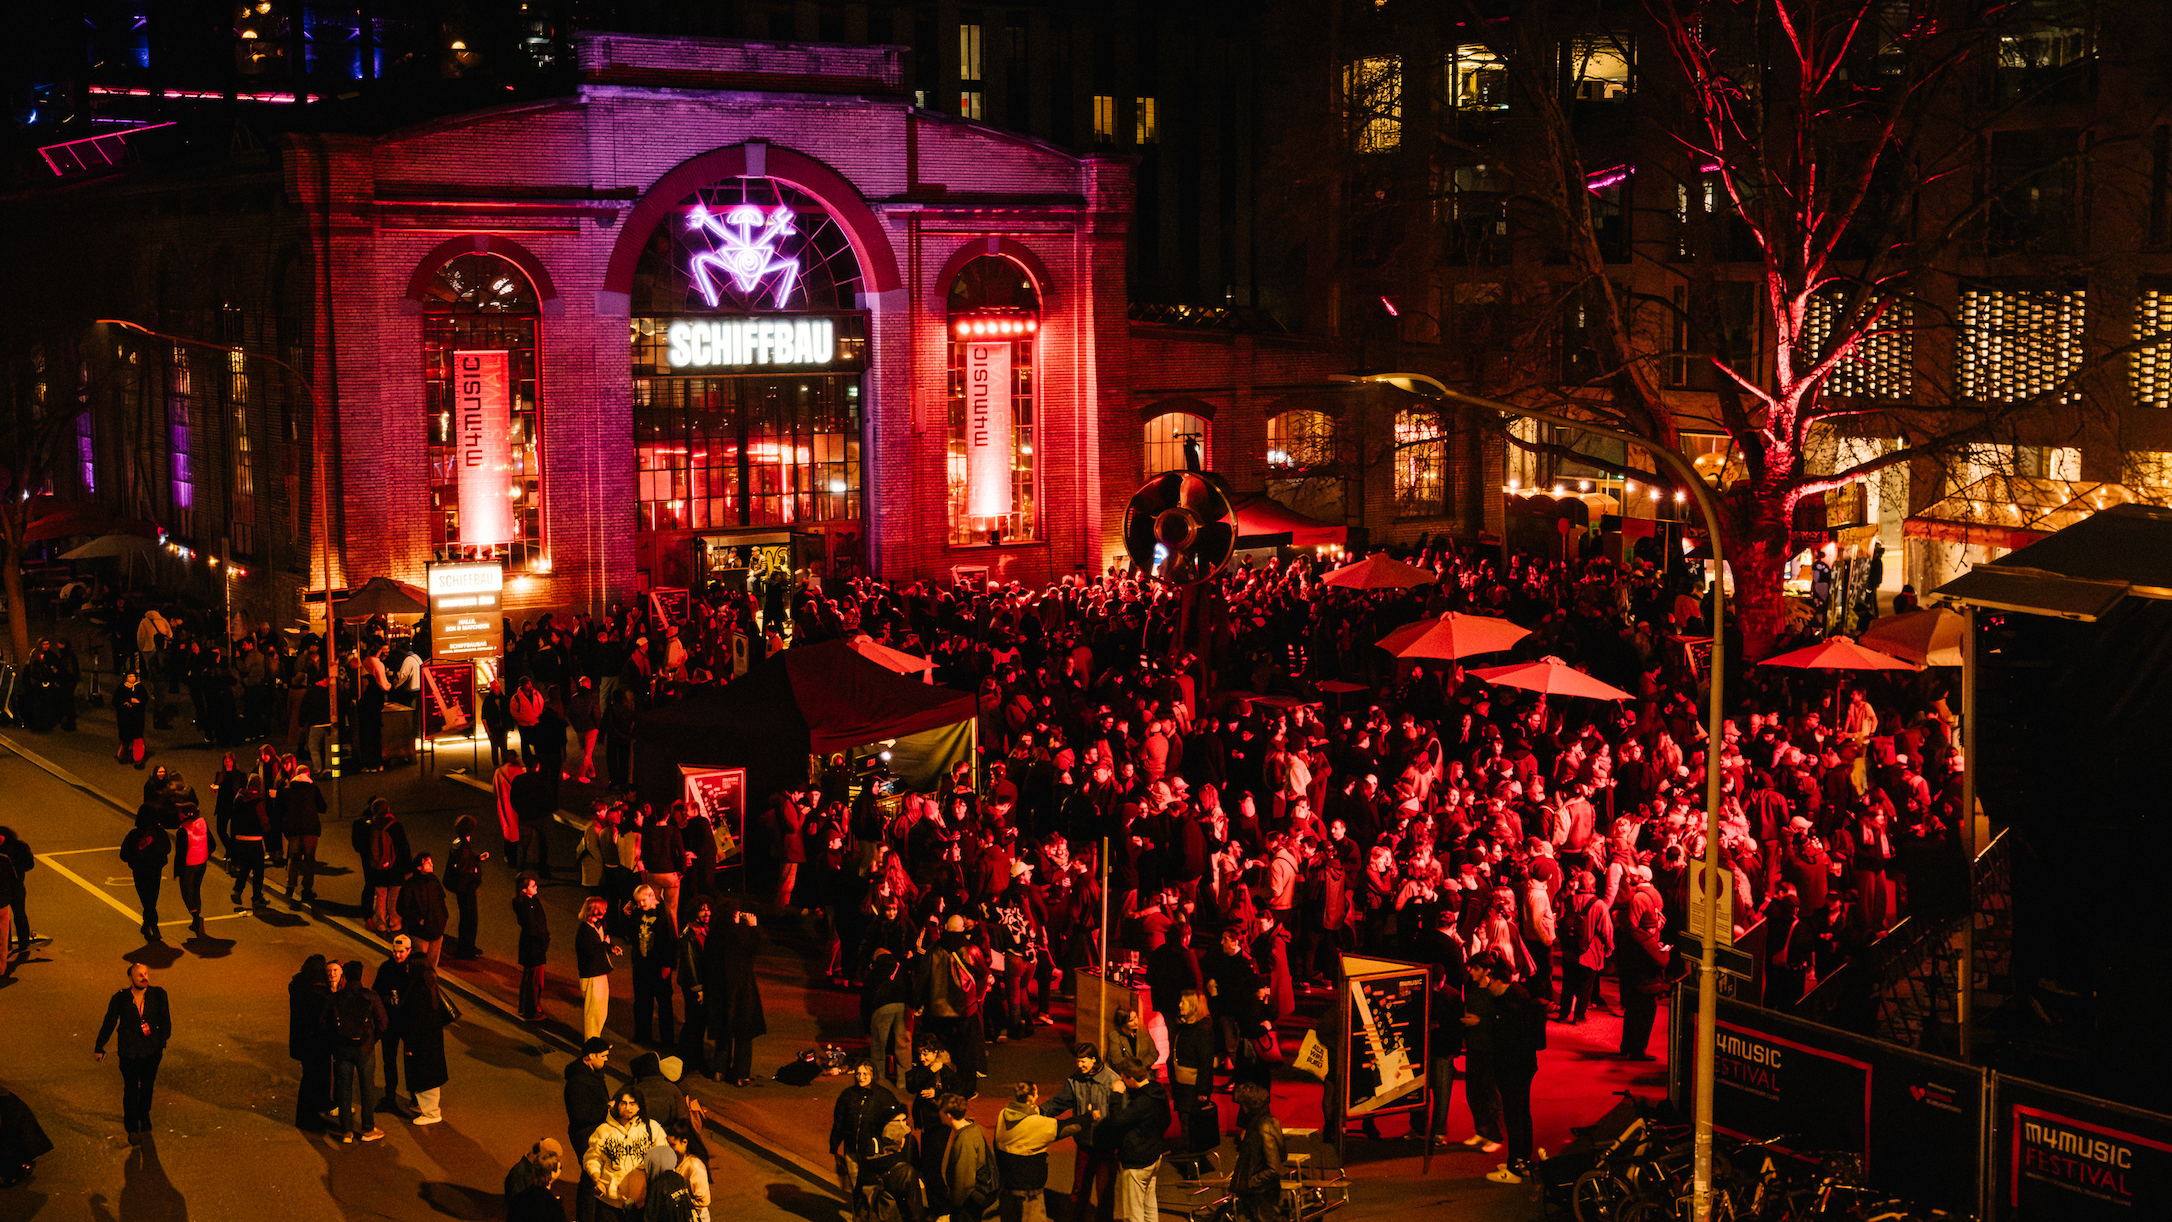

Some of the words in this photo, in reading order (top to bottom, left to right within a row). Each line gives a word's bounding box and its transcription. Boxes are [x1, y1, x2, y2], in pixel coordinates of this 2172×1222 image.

[670, 321, 833, 366] SCHIFFBAU
[439, 573, 493, 588] SCHIFFBAU
[1716, 1033, 1782, 1069] 4MUSIC
[1715, 1054, 1781, 1092] ESTIVAL
[2025, 1146, 2133, 1197] FESTIVAL
